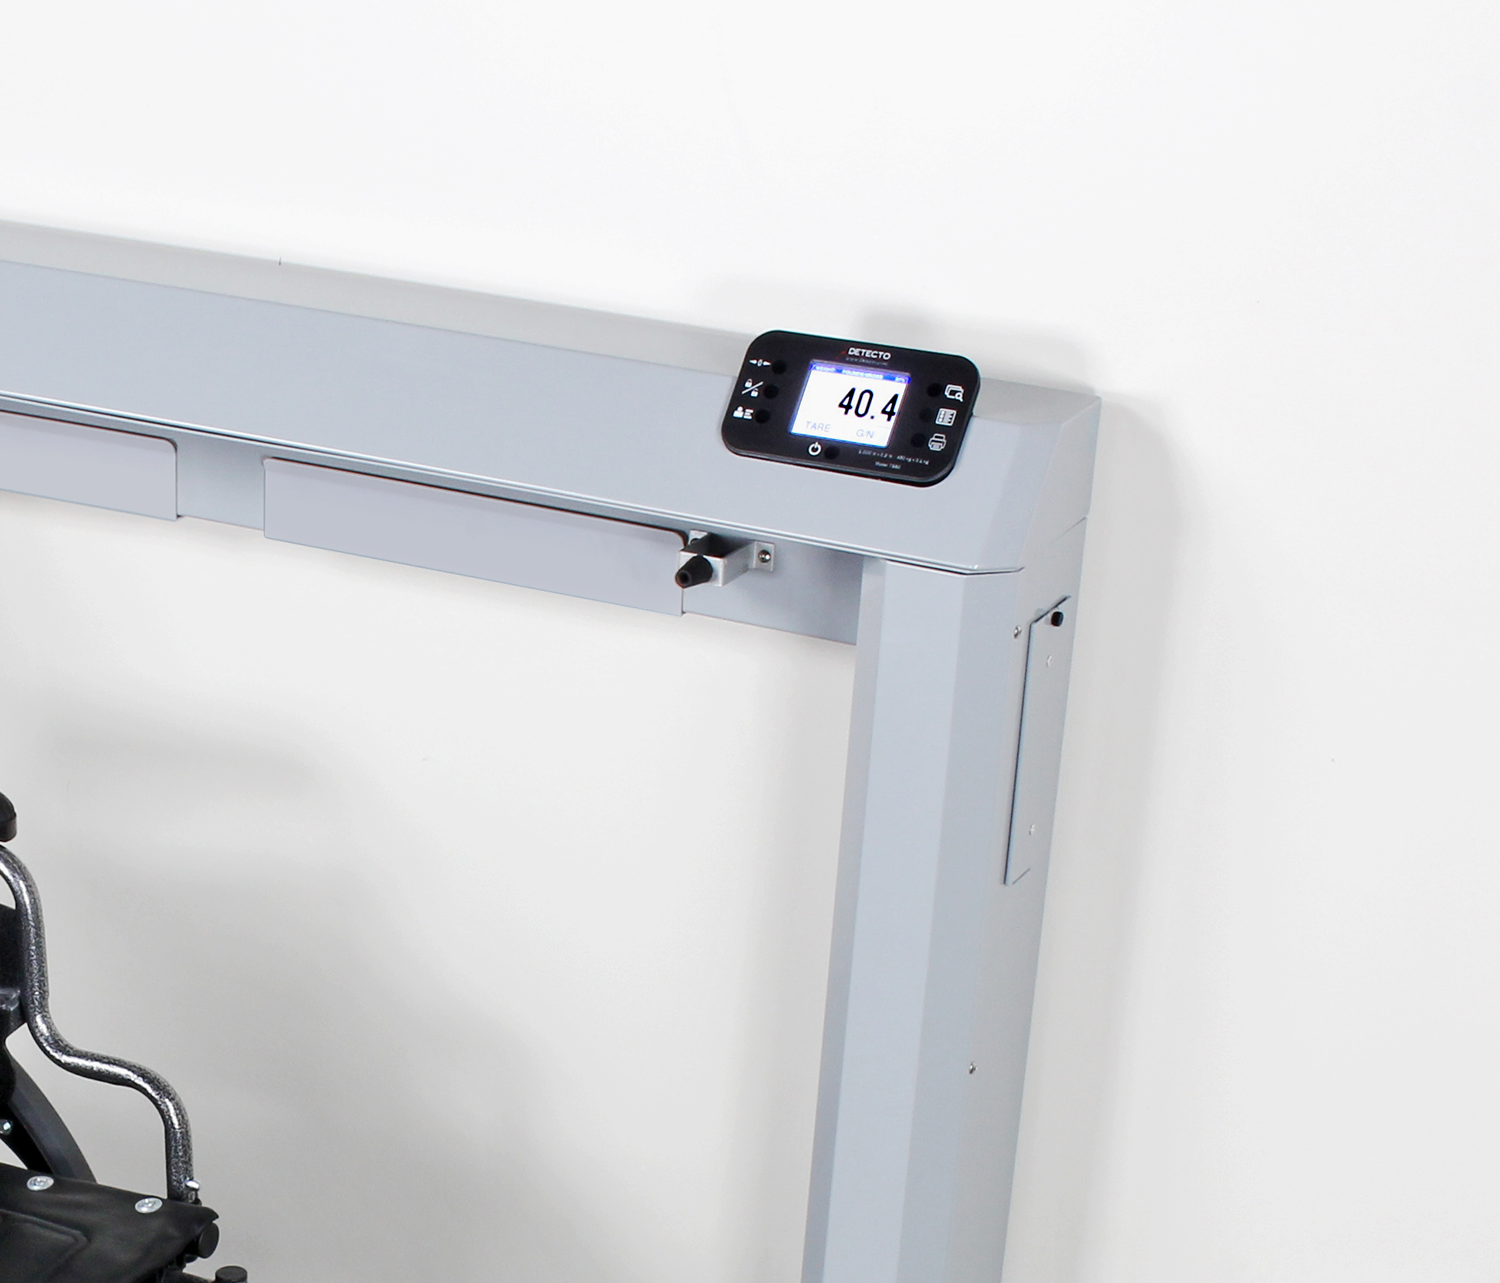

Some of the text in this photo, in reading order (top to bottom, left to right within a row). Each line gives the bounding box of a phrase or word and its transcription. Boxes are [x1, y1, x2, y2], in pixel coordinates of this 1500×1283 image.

[848, 347, 891, 359] DETECTO
[838, 387, 899, 421] 40.4
[805, 420, 831, 433] TARE
